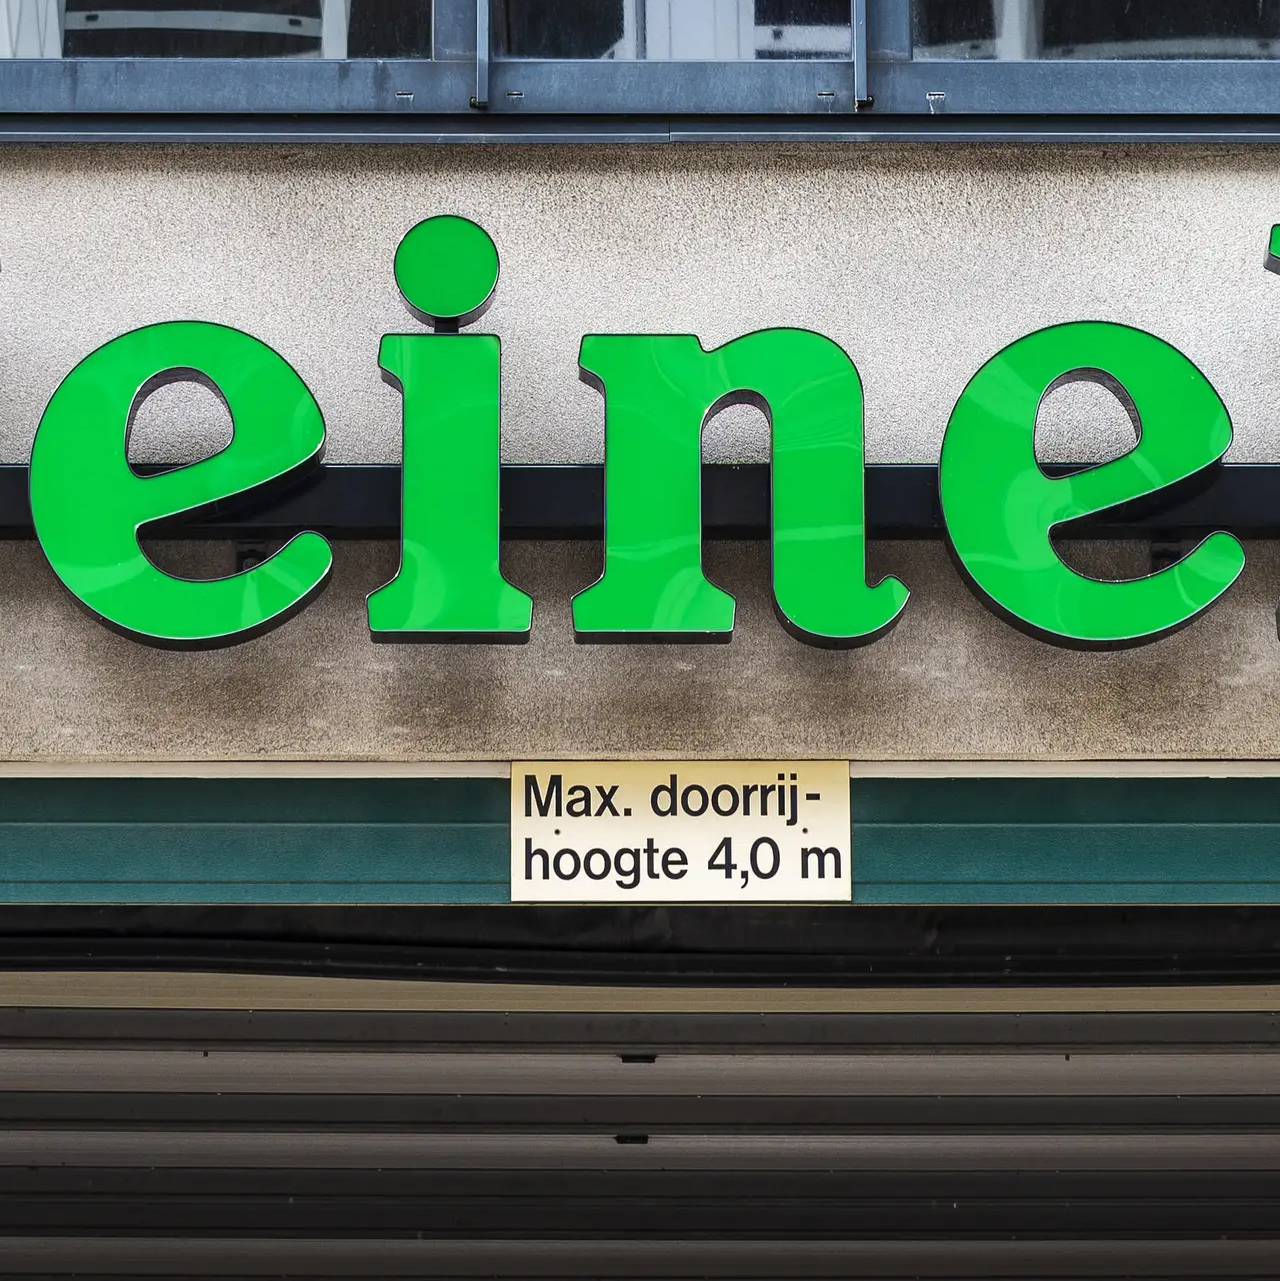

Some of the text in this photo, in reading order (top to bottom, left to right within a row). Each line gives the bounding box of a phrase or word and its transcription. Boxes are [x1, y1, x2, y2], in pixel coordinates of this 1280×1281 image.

[524, 773, 821, 827] Max. doorrij-
[524, 836, 842, 890] hoogte 4,0 m
